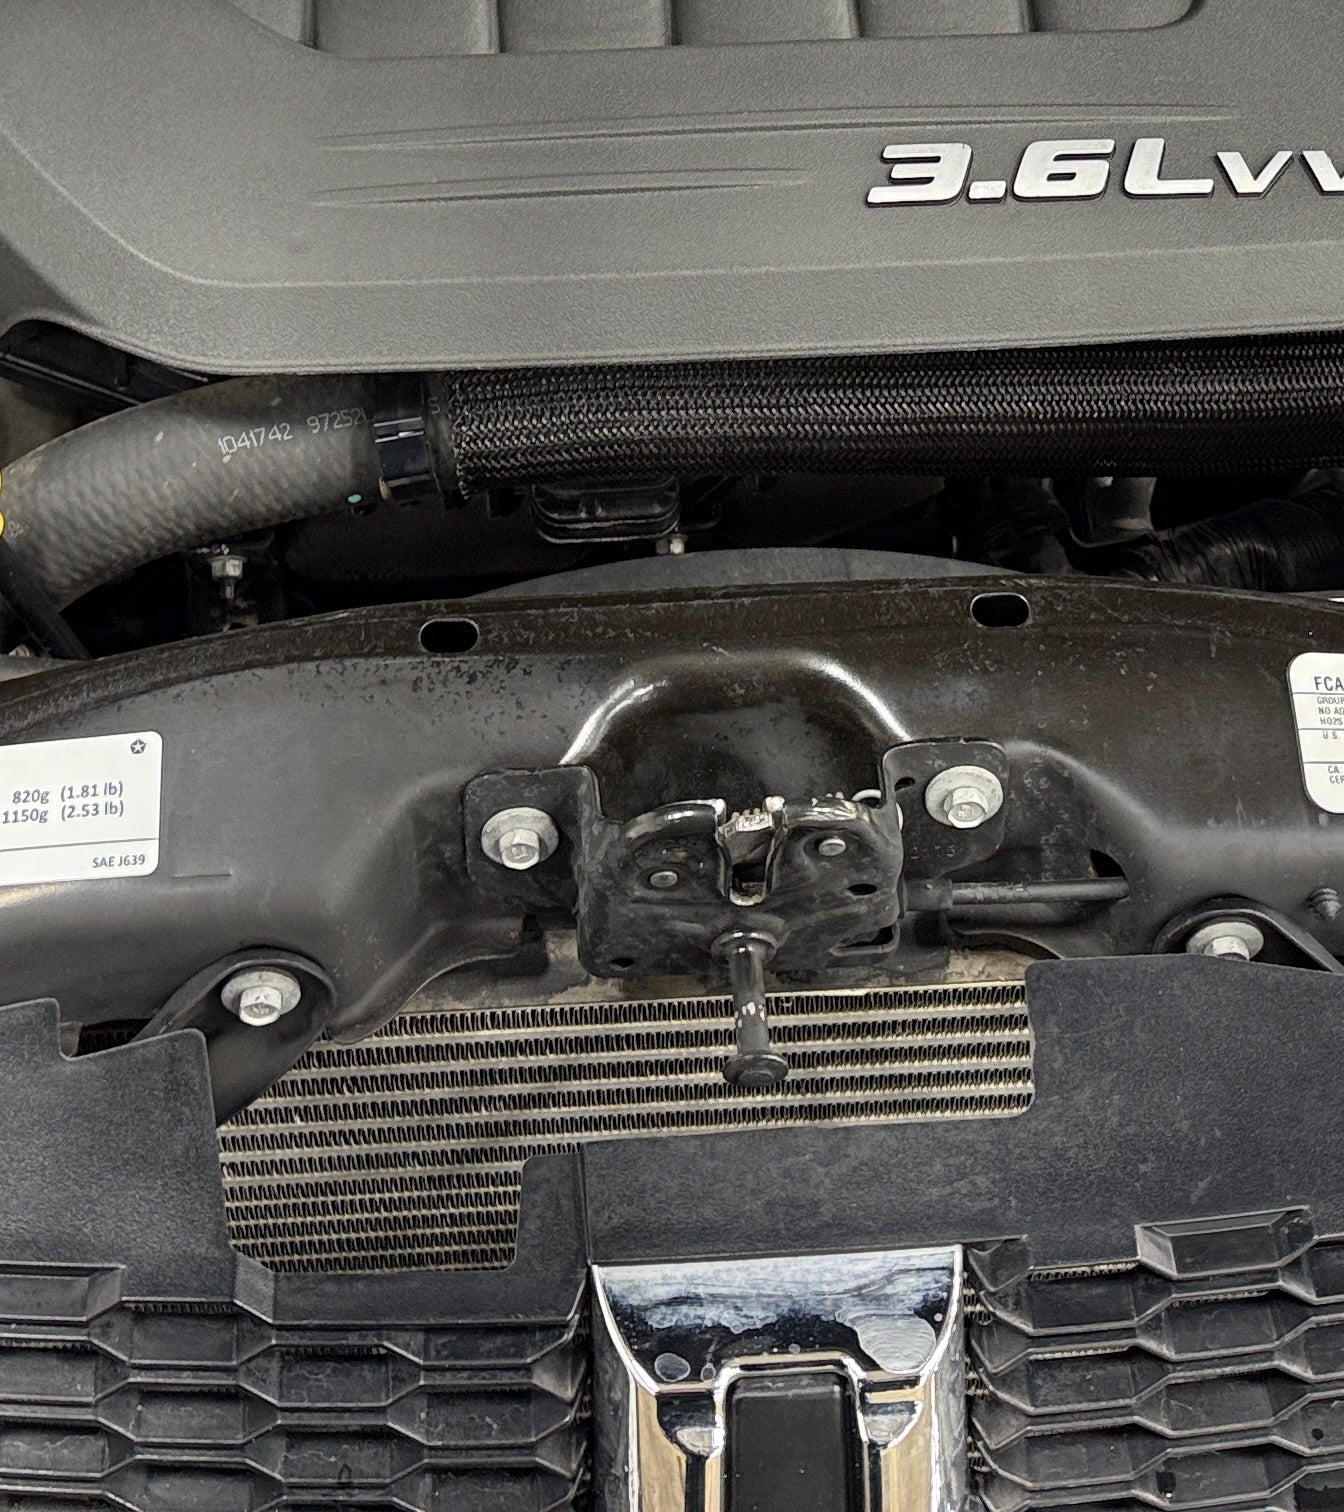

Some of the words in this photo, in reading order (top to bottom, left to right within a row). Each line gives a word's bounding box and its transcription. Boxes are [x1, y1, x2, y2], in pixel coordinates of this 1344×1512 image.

[217, 421, 295, 456] 1041742
[1318, 706, 1332, 716] NO
[11, 787, 51, 805] 820g
[60, 783, 100, 803] (1.81
[103, 780, 125, 798] lb)
[1, 808, 50, 826] 1150g
[60, 802, 101, 823] (2.53
[103, 799, 125, 817] lb)
[91, 855, 116, 870] SAE
[117, 853, 147, 868] J639
